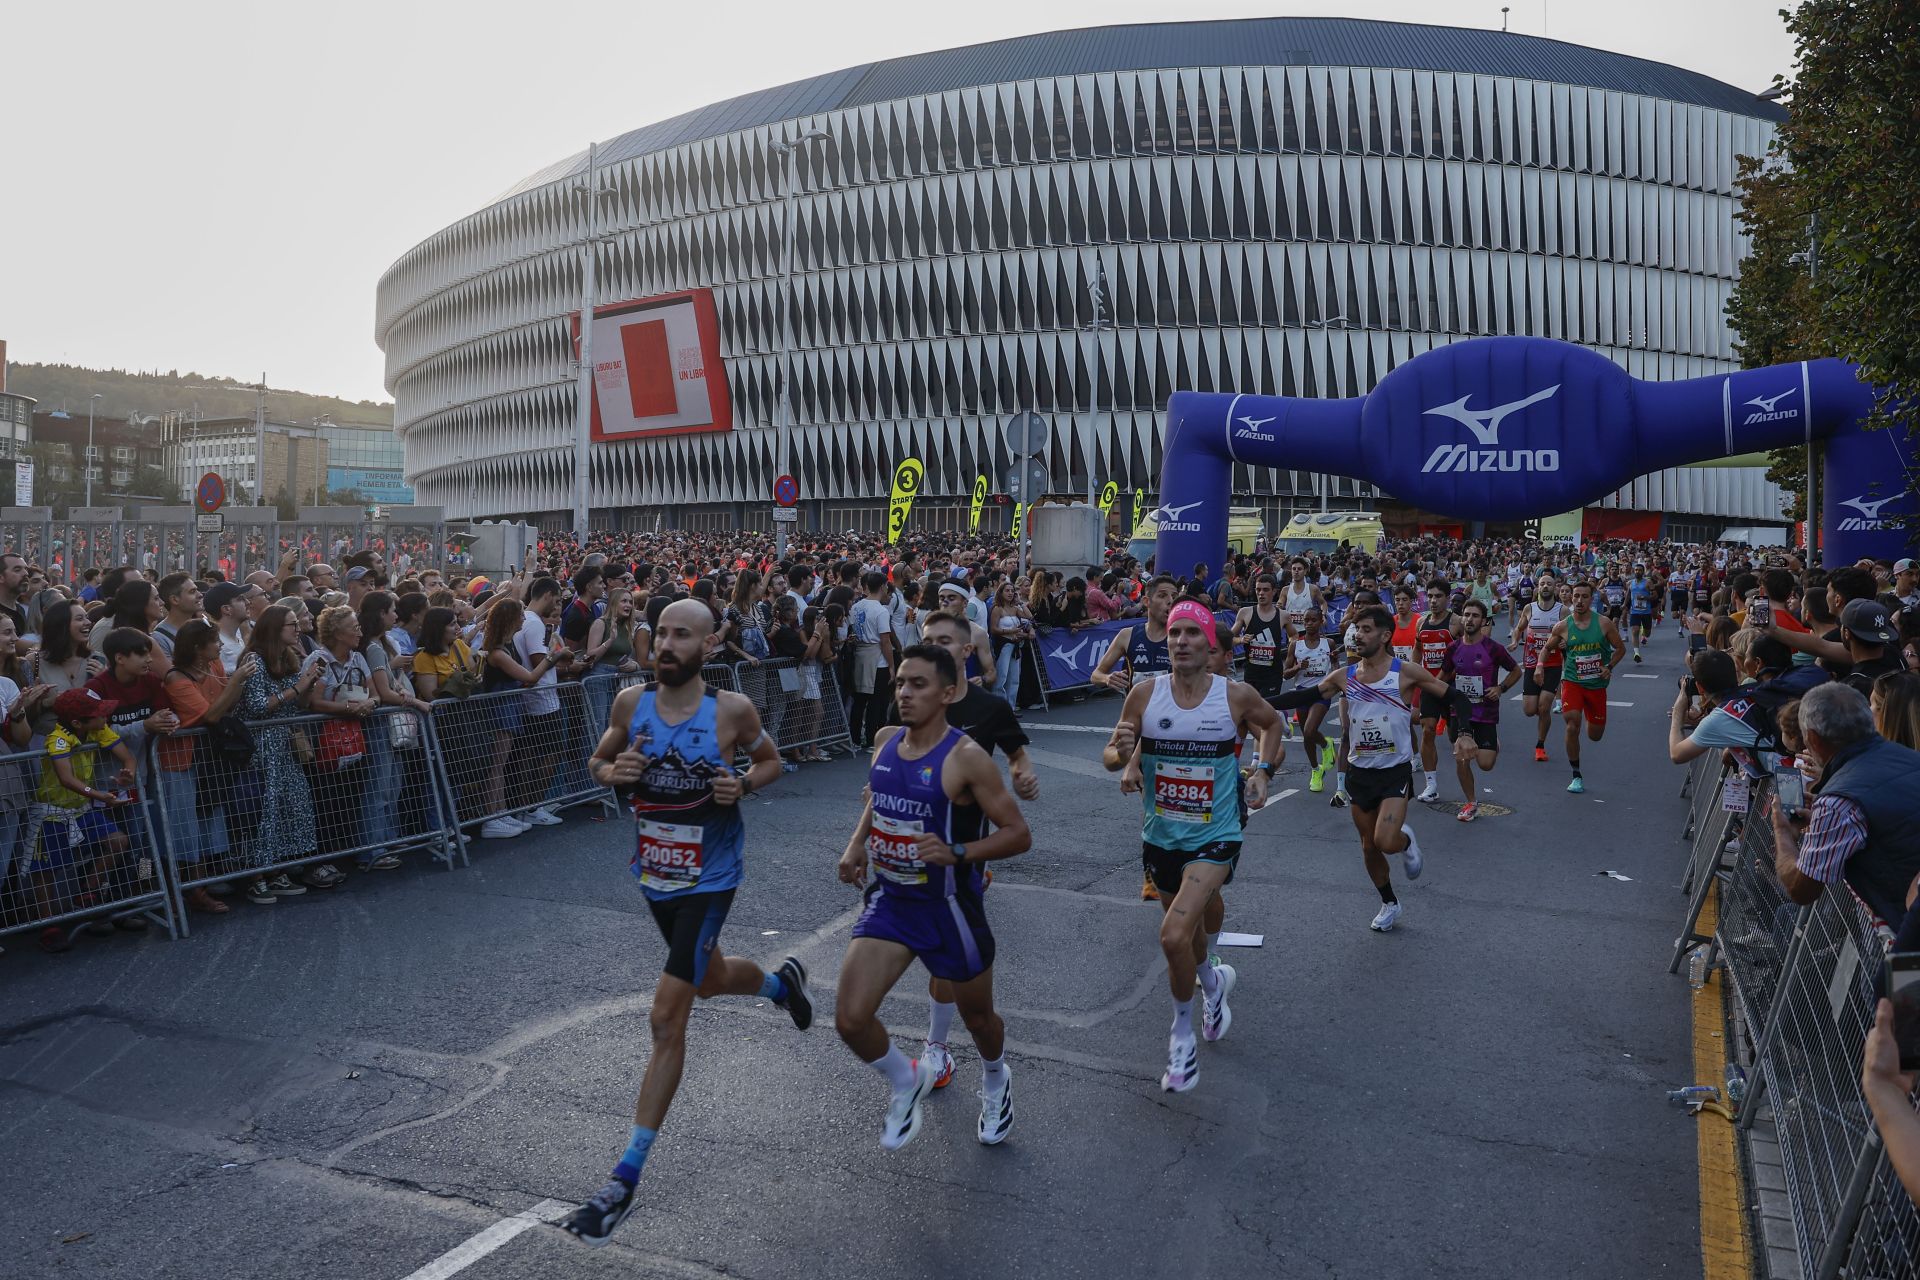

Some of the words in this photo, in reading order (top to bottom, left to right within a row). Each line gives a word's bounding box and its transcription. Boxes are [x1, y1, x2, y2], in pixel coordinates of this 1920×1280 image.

[680, 371, 688, 380] UN
[902, 470, 914, 489] 3
[892, 496, 914, 505] START
[892, 507, 903, 532] 3
[1733, 699, 1749, 713] 27
[1361, 731, 1382, 742] 122
[1155, 741, 1185, 751] Peñota
[1188, 742, 1218, 752] Dental
[1159, 782, 1209, 800] 28384
[642, 843, 697, 866] 20052
